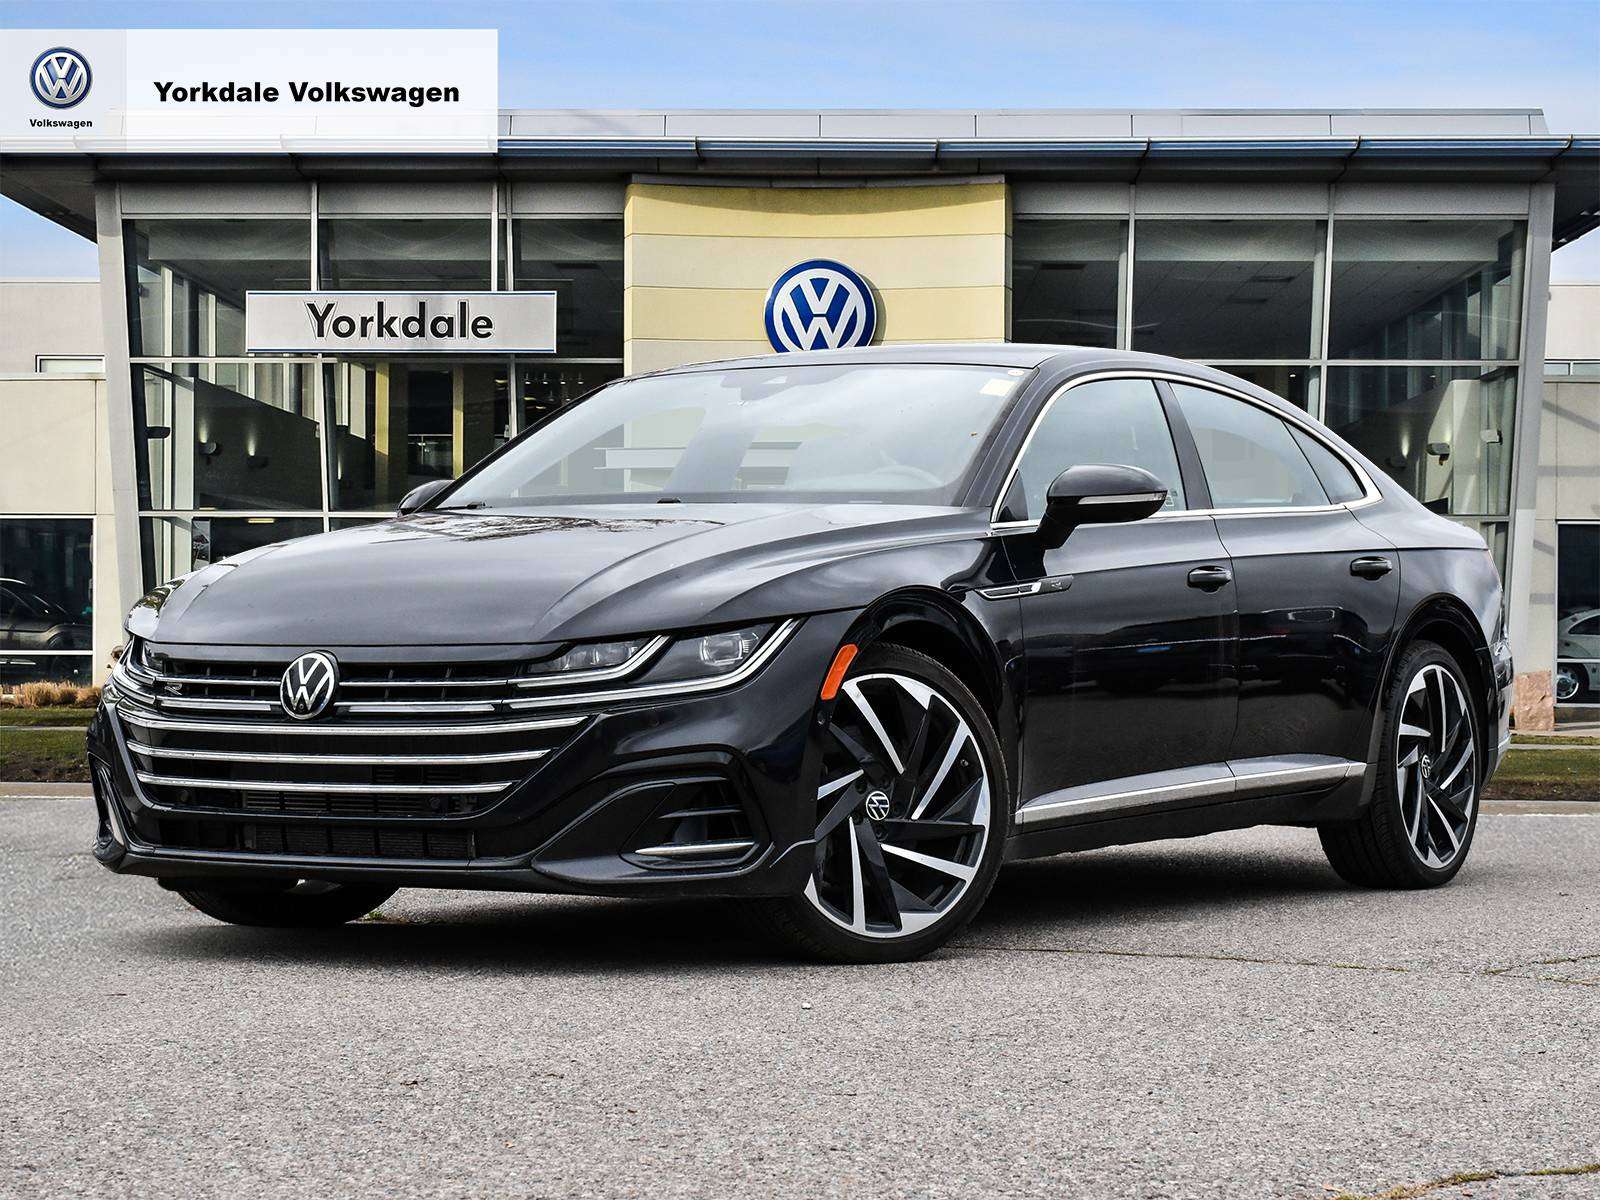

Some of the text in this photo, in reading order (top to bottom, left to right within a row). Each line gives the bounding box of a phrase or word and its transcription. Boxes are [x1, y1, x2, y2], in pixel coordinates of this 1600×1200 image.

[305, 300, 494, 339] Yorkdale
[772, 266, 867, 352] VW
[281, 652, 335, 718] VW
